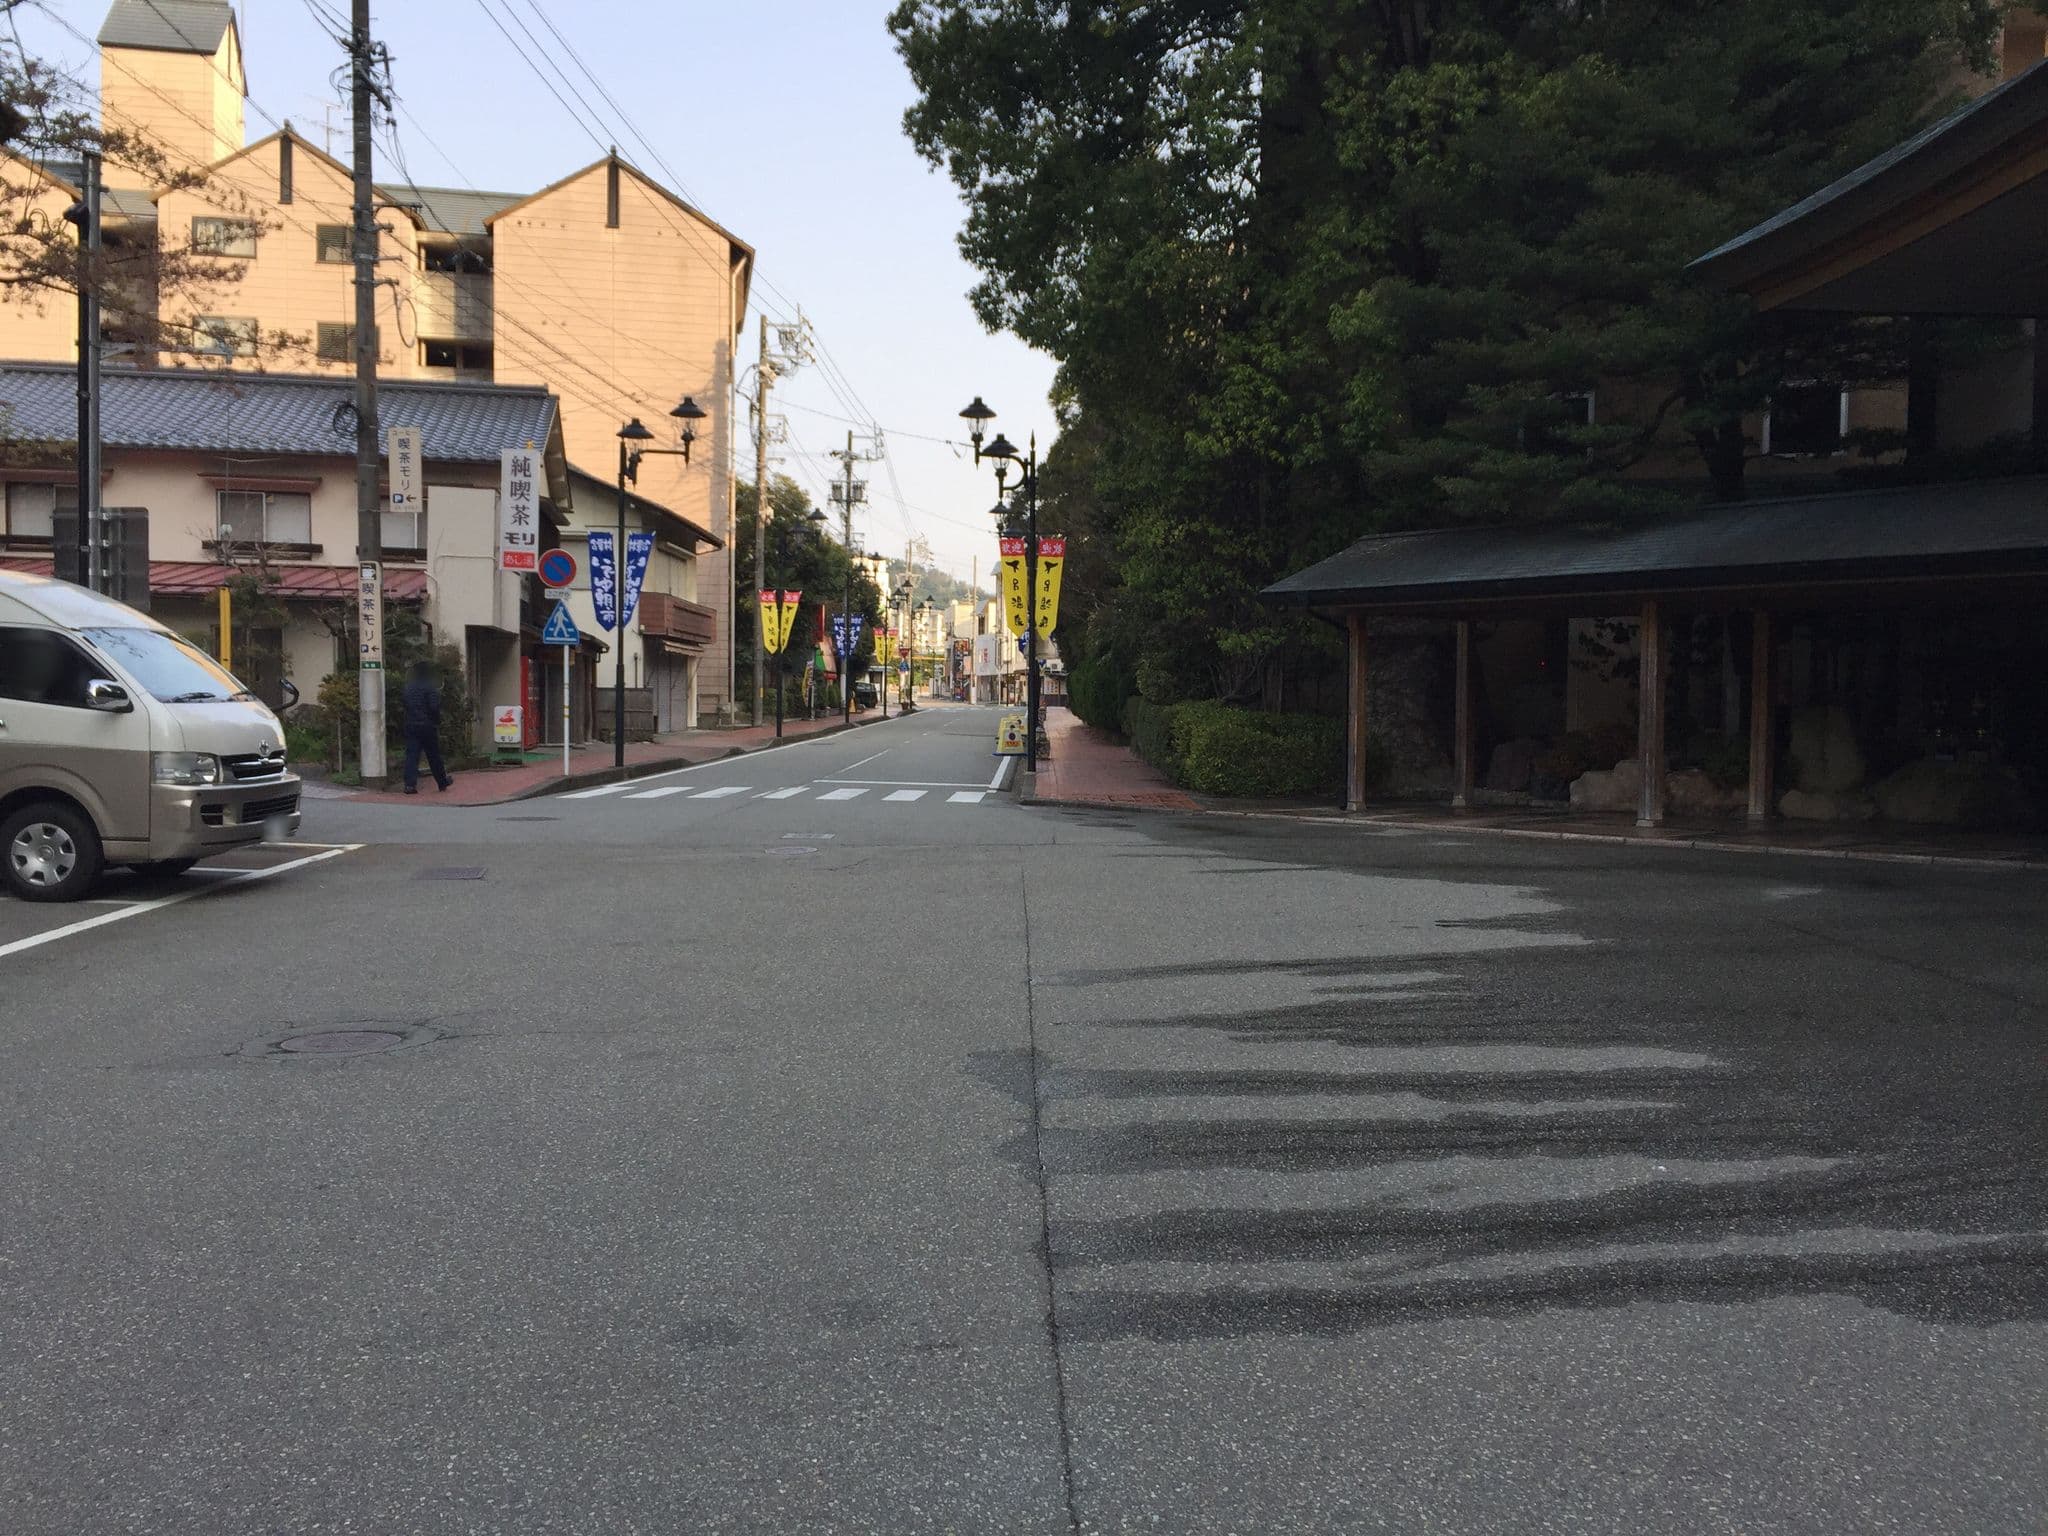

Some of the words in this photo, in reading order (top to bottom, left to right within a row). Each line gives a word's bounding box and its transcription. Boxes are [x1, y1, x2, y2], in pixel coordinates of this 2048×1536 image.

[398, 438, 410, 490] 喫茶モリ
[510, 455, 532, 526] 純喫茶
[504, 532, 535, 545] モリ
[362, 583, 375, 640] 喫茶モリ
